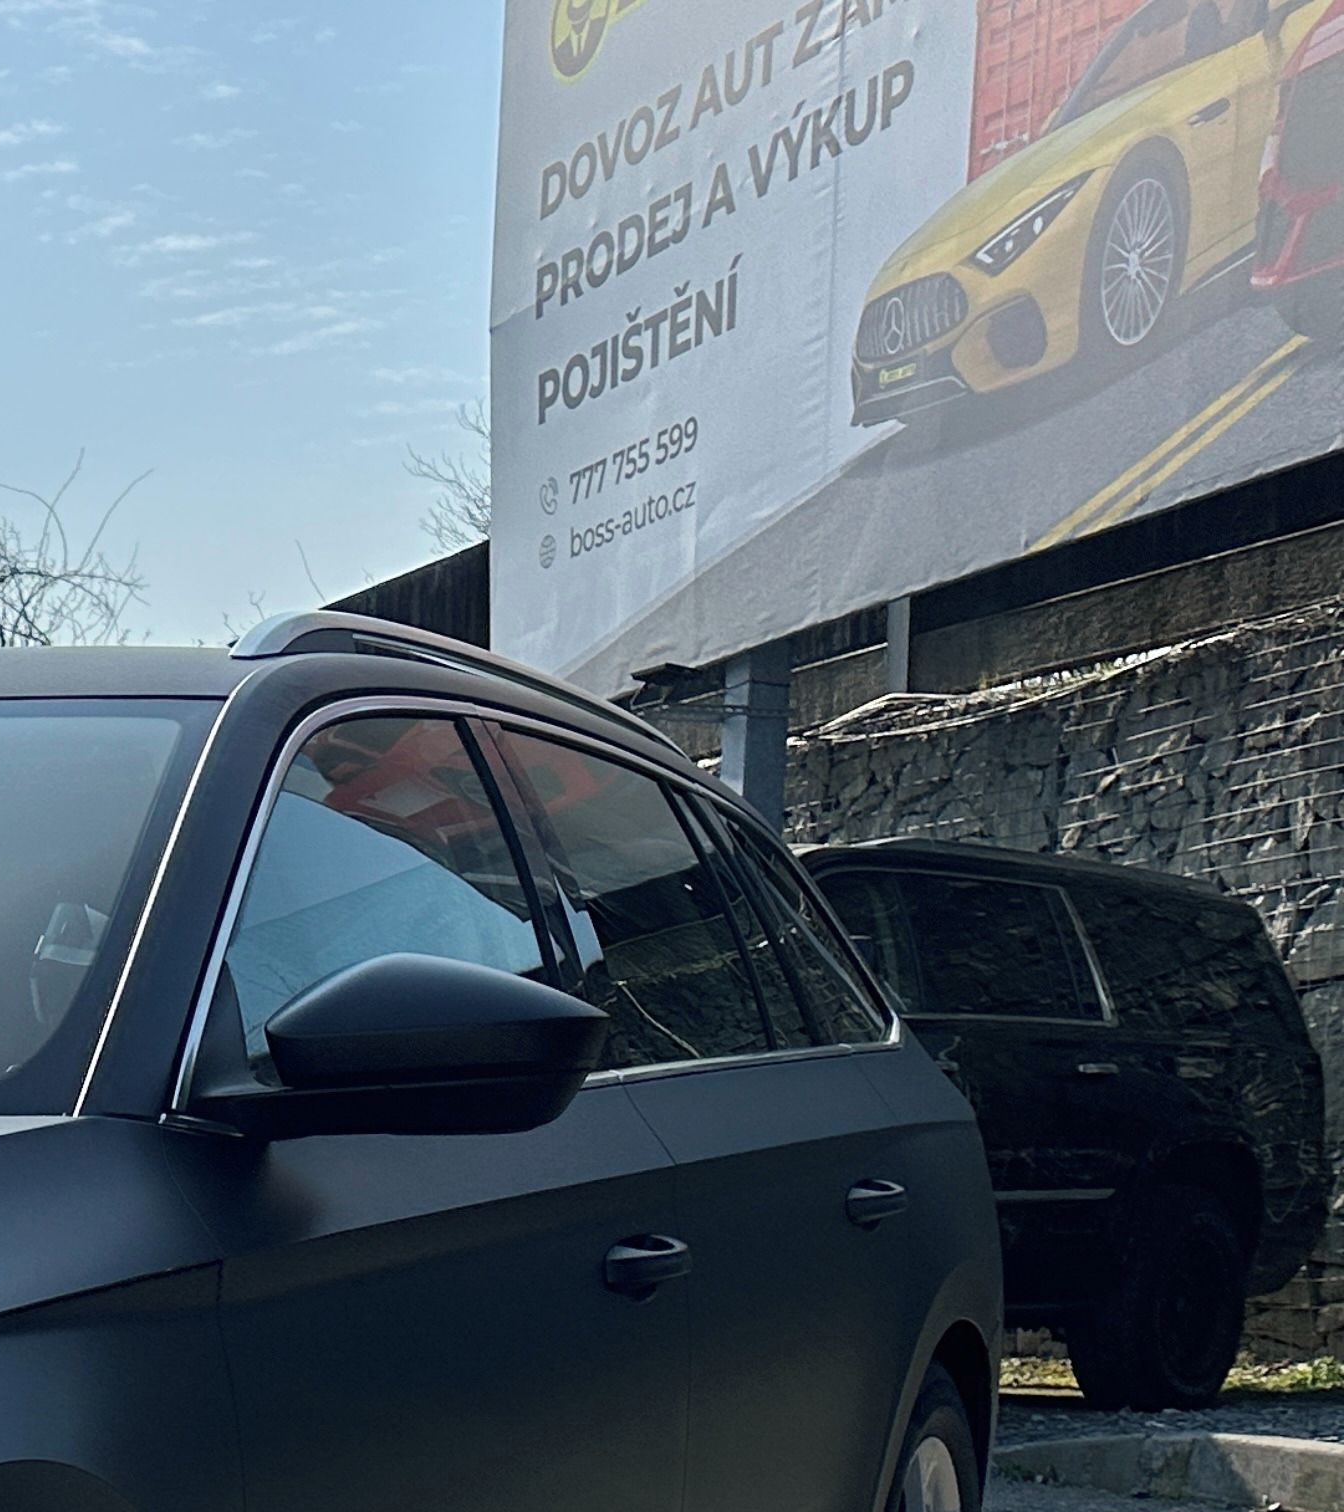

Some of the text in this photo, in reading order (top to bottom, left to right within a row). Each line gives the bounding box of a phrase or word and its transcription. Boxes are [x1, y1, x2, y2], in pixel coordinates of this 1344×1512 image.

[535, 59, 914, 320] PRODEJ A VÝKUP
[540, 84, 682, 220] DOVOZ
[689, 20, 783, 131] AUT
[538, 253, 743, 425] POJIŠTĚNÍ
[569, 416, 699, 504] 777 755 599
[570, 481, 697, 558] boss-auto.cz
